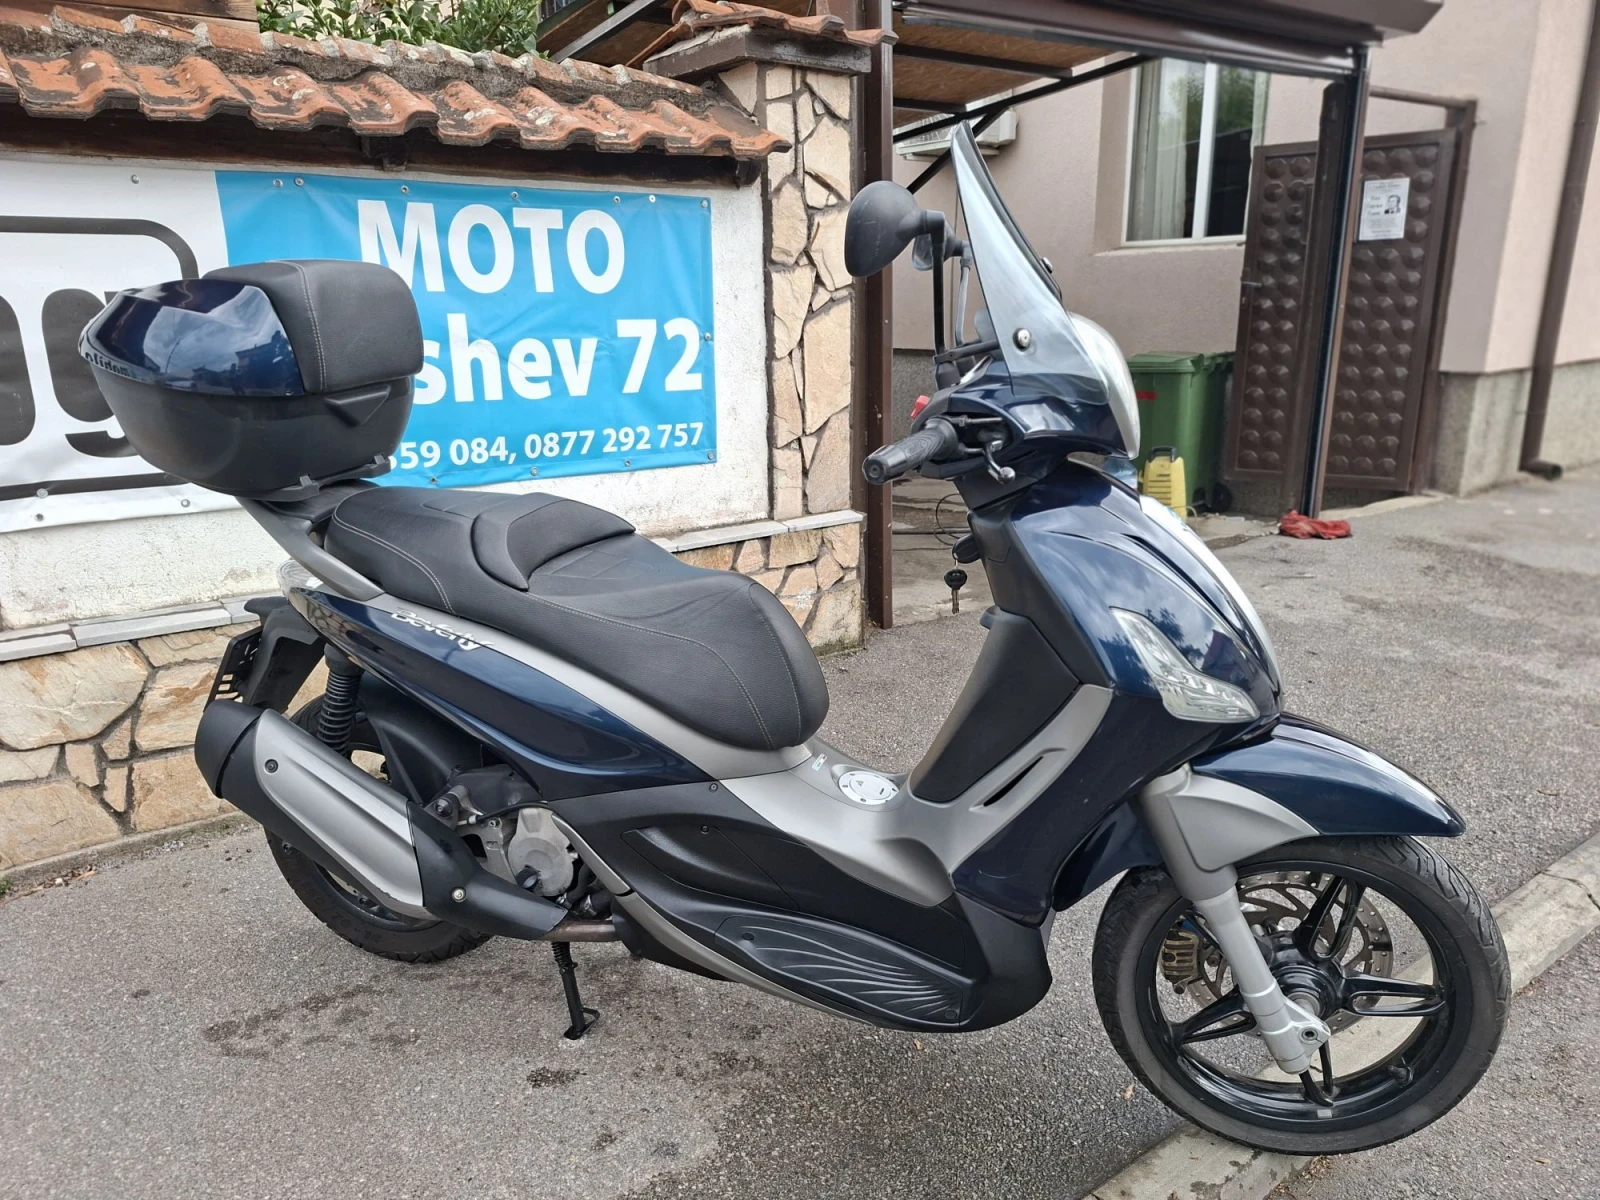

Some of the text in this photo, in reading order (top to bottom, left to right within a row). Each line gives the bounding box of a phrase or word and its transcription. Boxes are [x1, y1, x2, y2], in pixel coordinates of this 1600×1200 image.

[358, 199, 625, 295] MOTO
[616, 317, 703, 394] 72
[449, 436, 516, 466] 084,
[524, 429, 595, 460] 0877
[602, 425, 652, 453] 292
[657, 422, 704, 449] 757
[390, 606, 495, 652] Beverly
